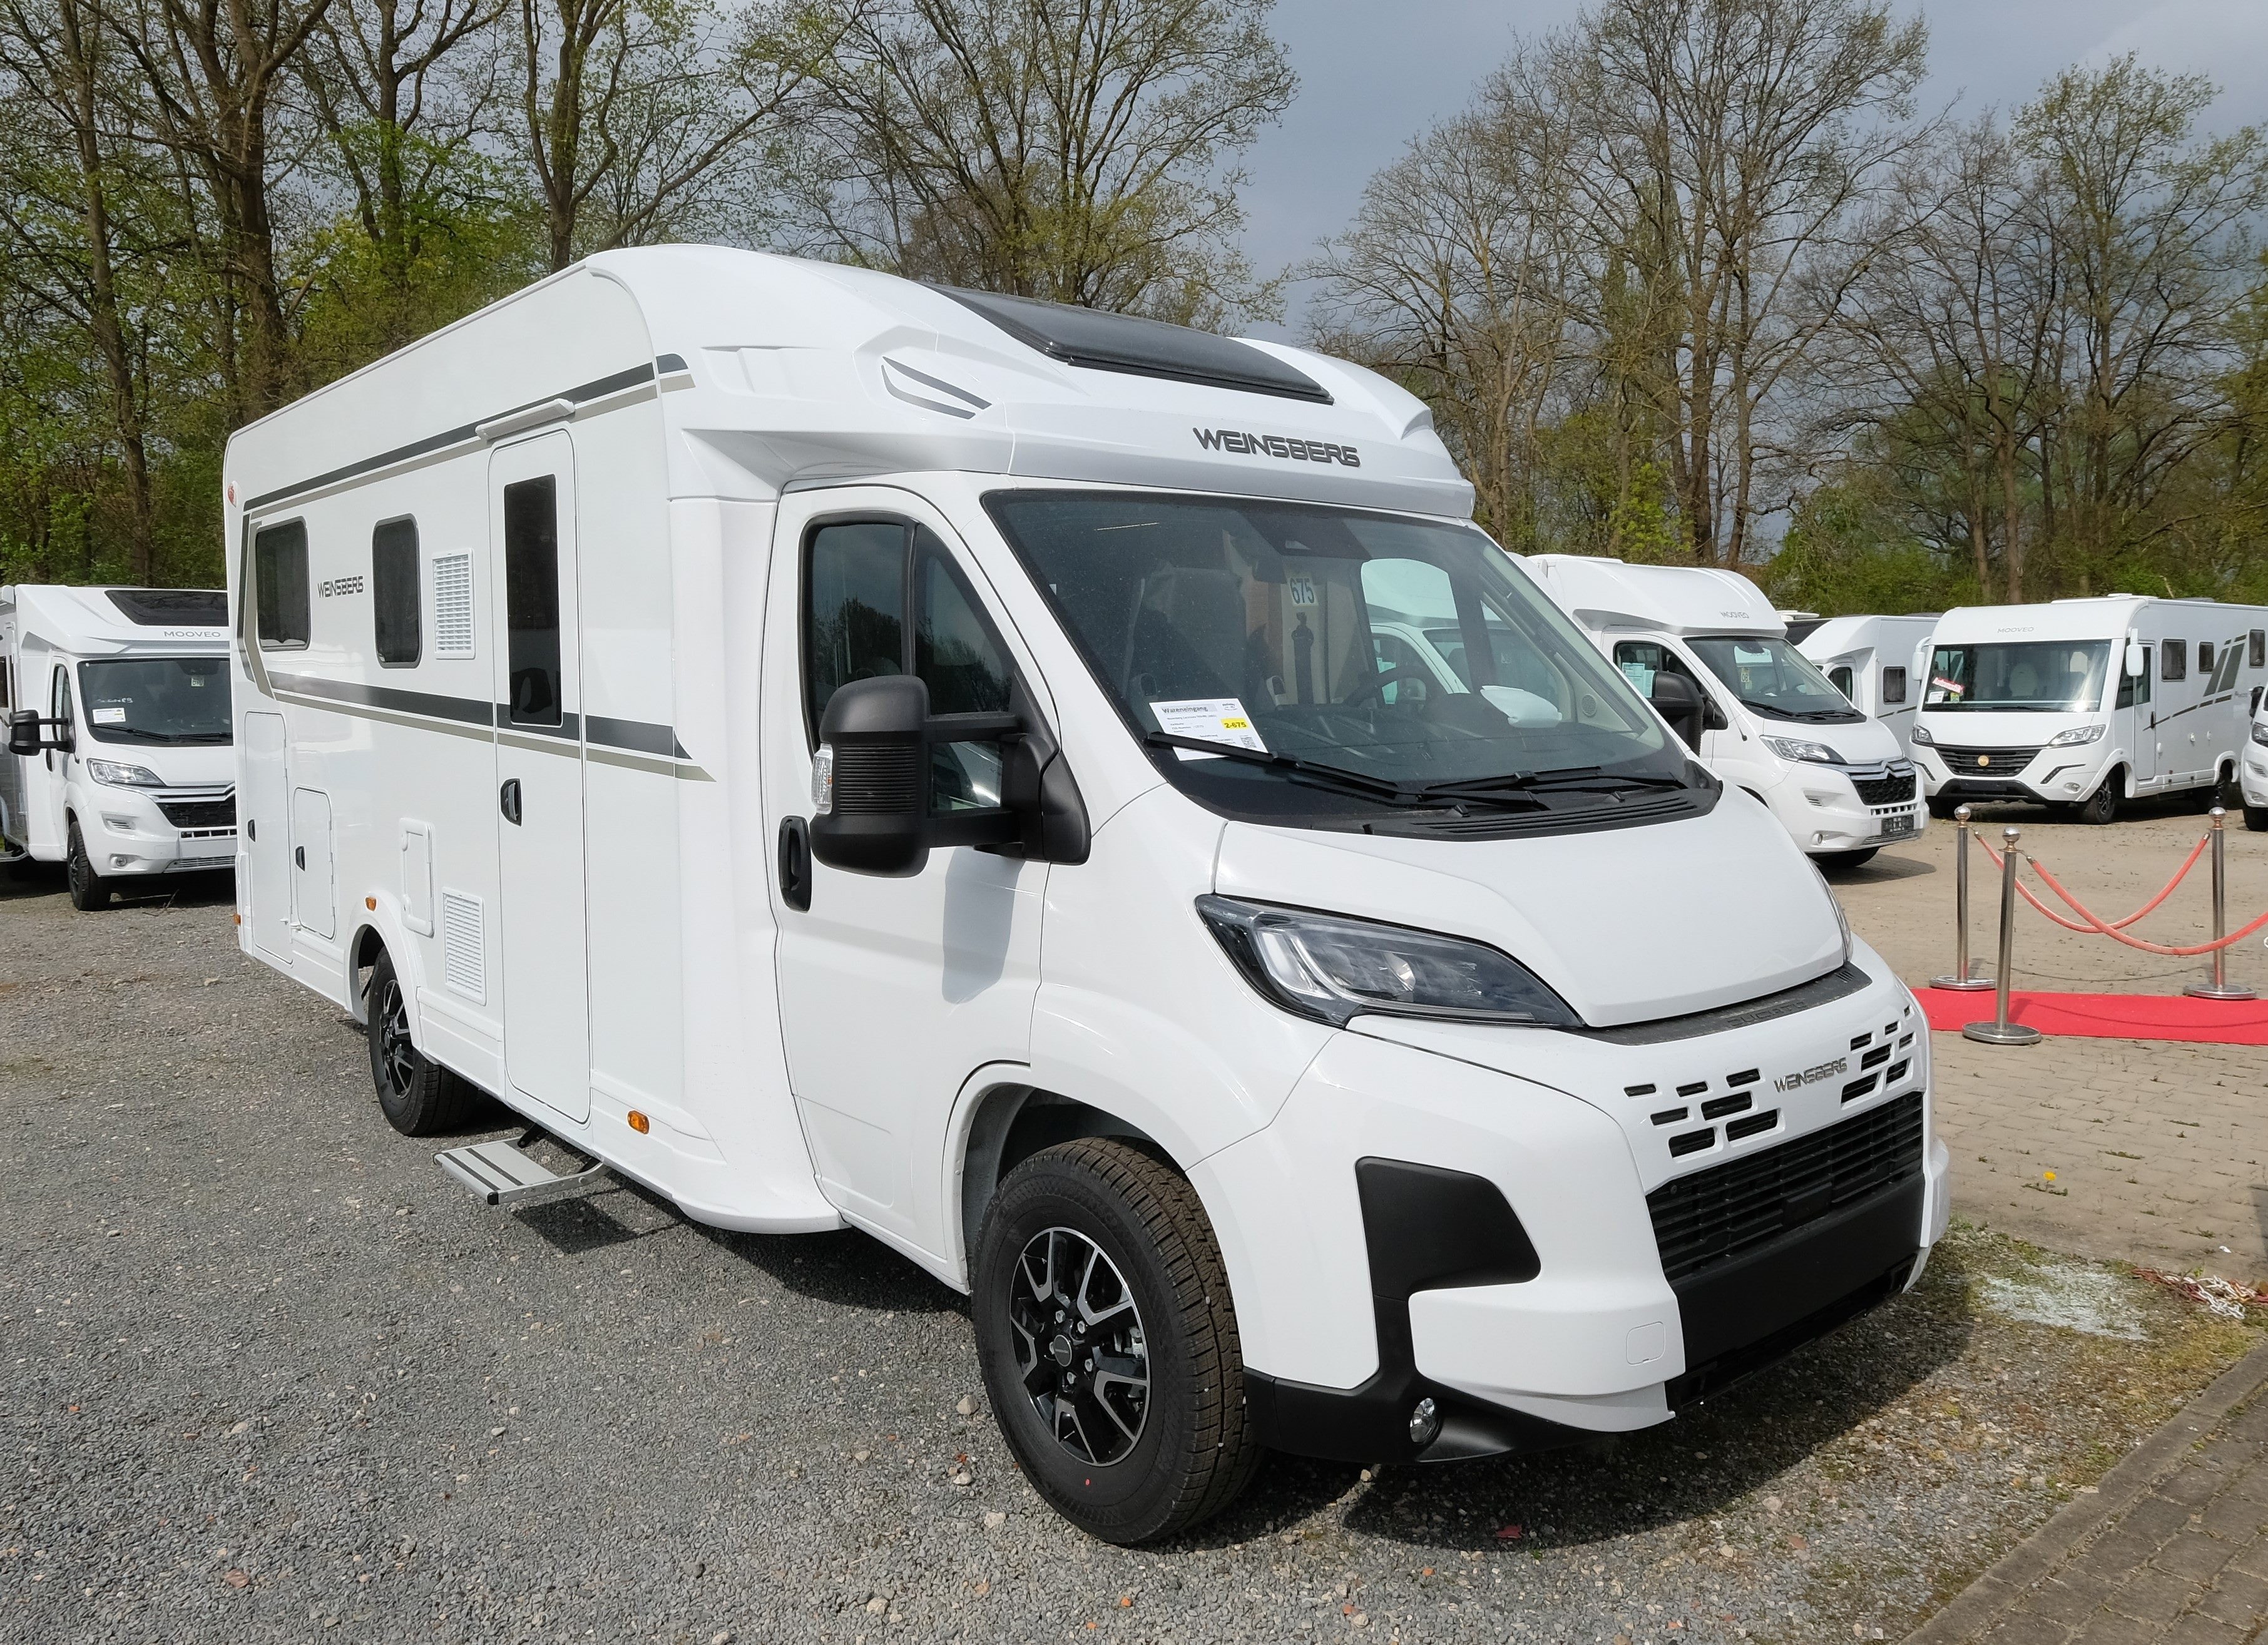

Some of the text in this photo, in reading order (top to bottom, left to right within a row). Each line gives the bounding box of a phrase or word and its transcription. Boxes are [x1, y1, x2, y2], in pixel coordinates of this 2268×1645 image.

[1193, 427, 1361, 467] WEINSBERG
[317, 576, 364, 598] WEINSBERG
[1290, 578, 1314, 604] 675
[1162, 706, 1208, 714] Wareneingang
[1774, 1057, 1847, 1092] WEINSBERG
